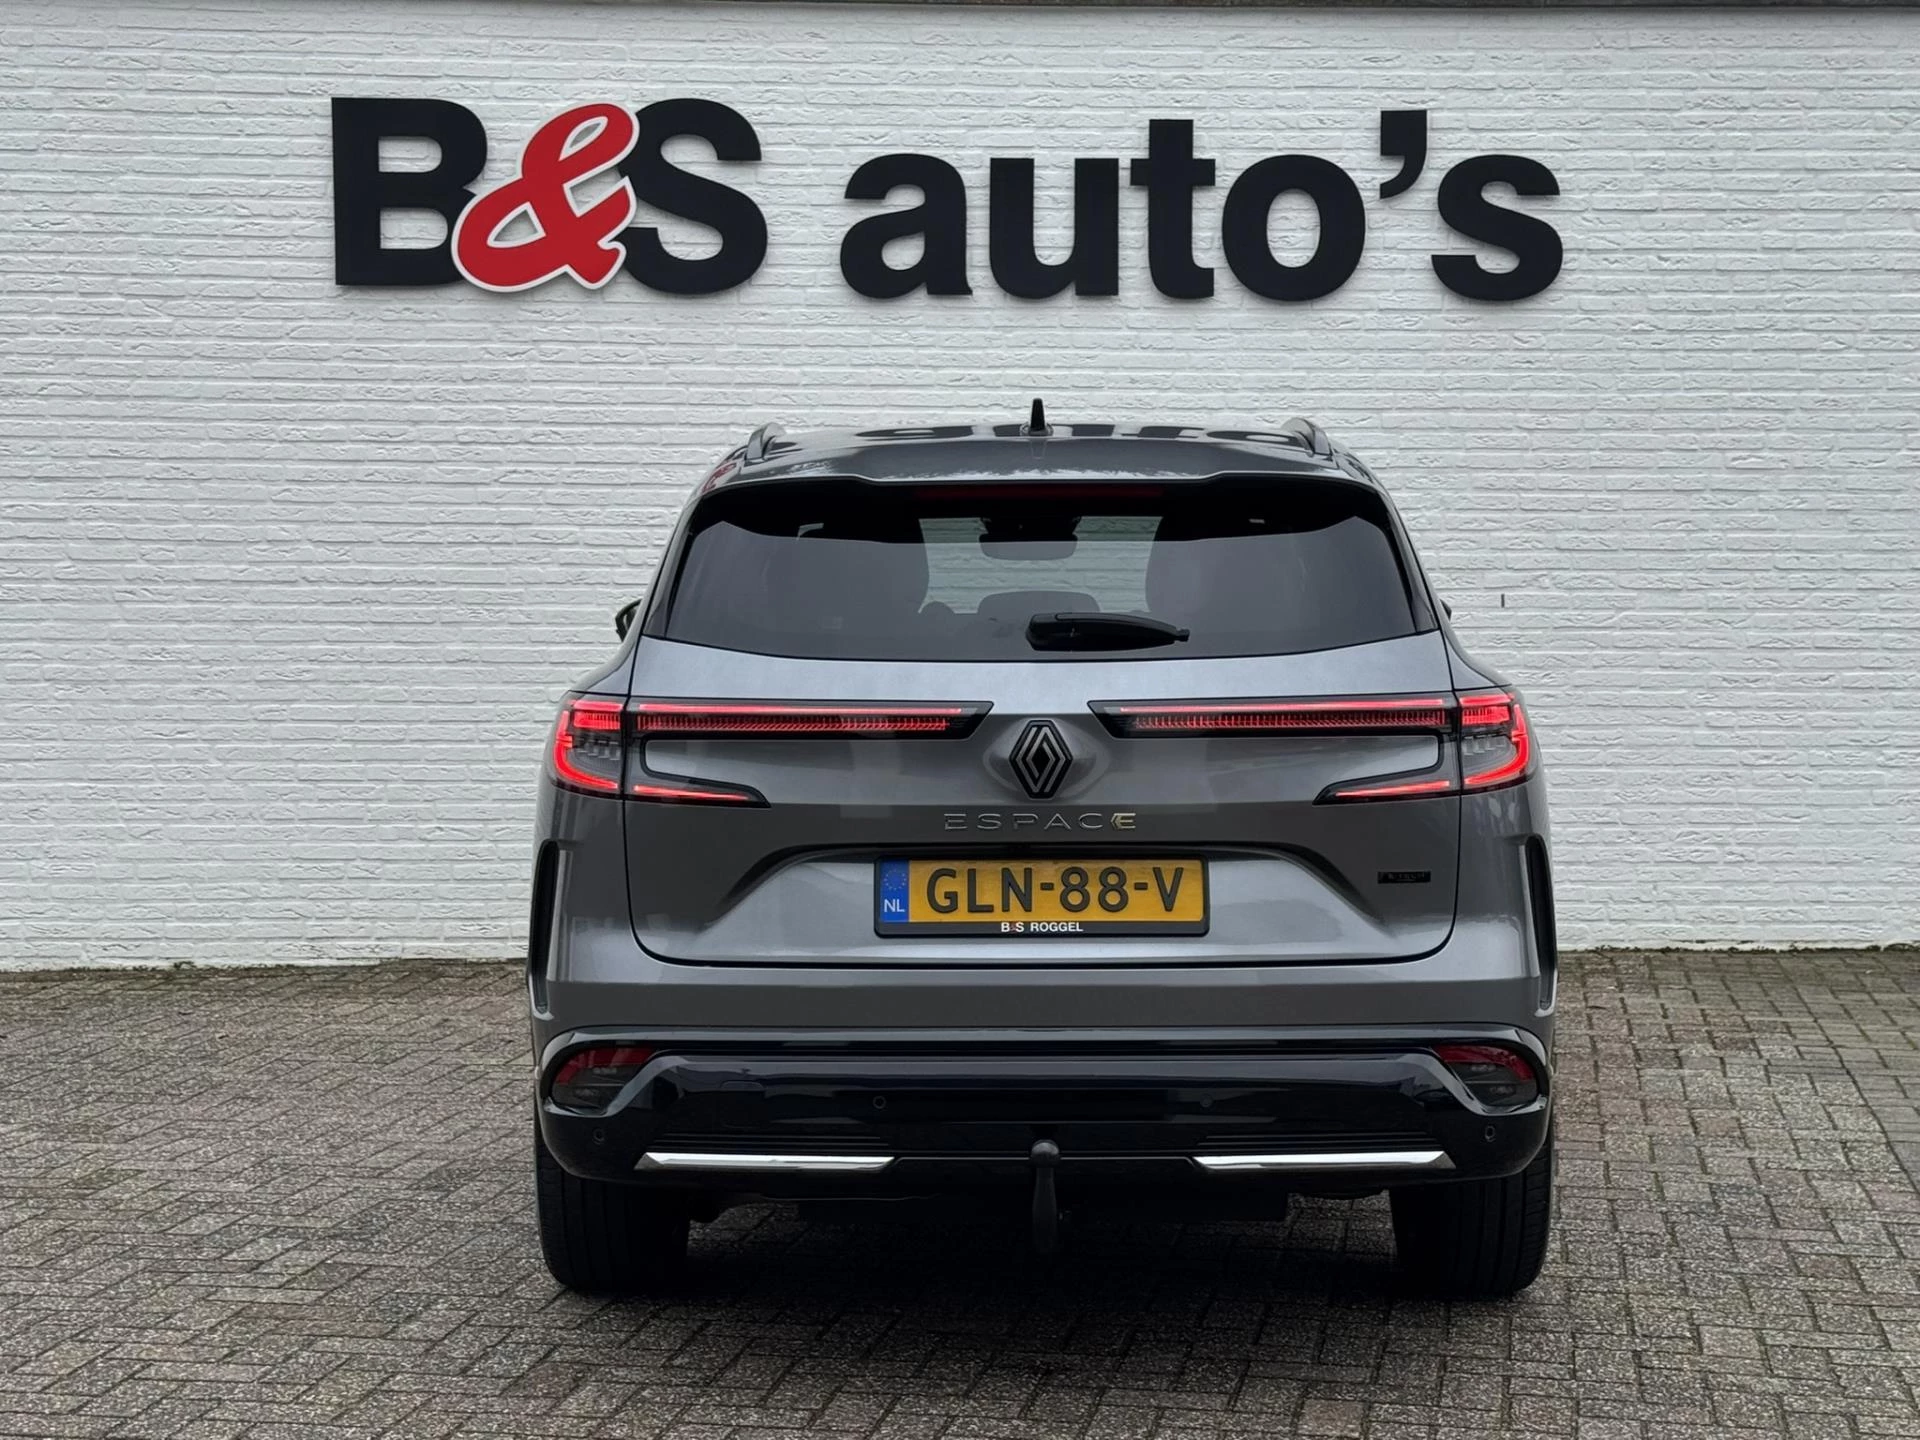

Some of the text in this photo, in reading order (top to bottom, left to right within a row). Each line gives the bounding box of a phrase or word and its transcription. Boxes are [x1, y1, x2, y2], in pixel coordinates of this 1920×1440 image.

[331, 97, 1564, 302] B&S auto's
[943, 813, 1136, 830] ESPACE
[926, 866, 1183, 914] GLN-88-V
[883, 898, 905, 913] NL
[1030, 922, 1084, 932] ROGGEL
